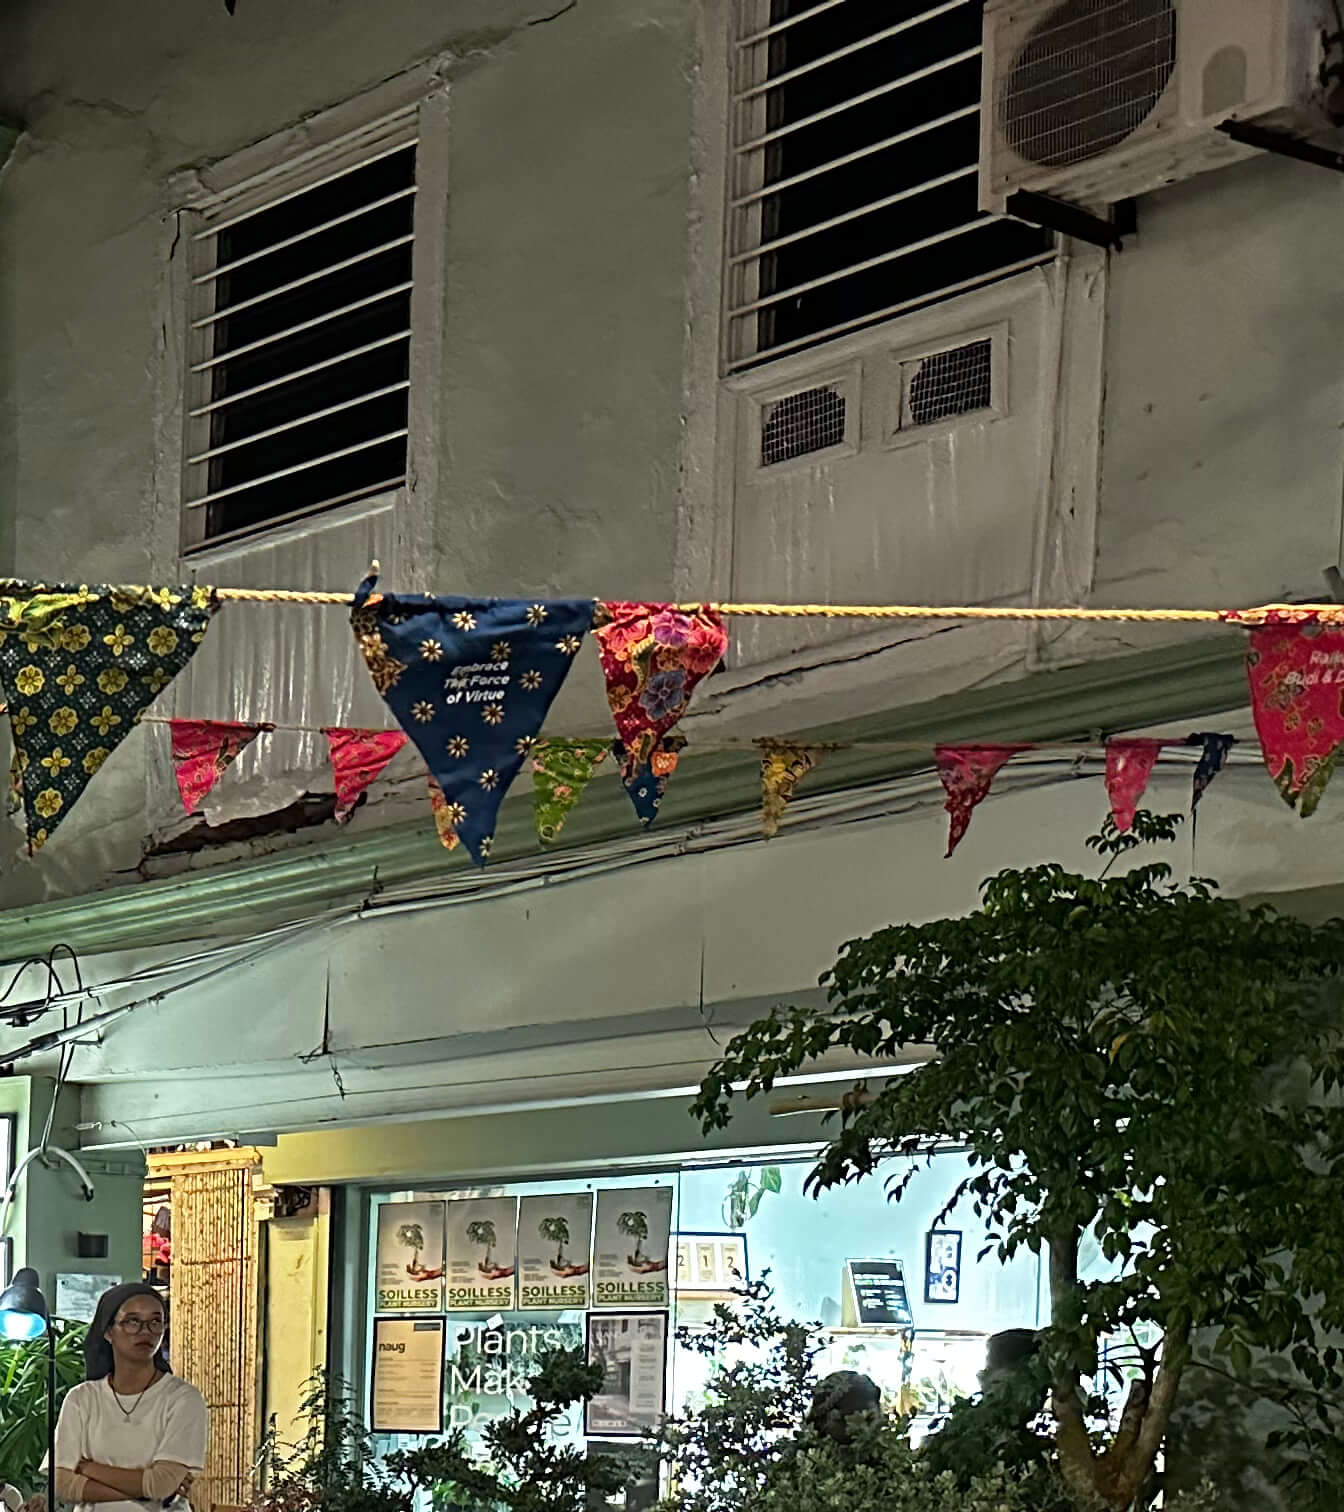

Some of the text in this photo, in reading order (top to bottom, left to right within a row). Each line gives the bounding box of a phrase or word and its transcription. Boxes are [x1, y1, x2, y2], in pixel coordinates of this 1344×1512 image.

[451, 661, 509, 676] Embrace
[470, 675, 510, 686] Force
[446, 690, 505, 704] of Virtue
[448, 1287, 512, 1298] SOILLESS
[522, 1285, 585, 1297] SOILLESS
[597, 1282, 665, 1293] SOILLESS
[378, 1288, 438, 1300] SOILLESS
[455, 1324, 565, 1355] Plants
[378, 1342, 407, 1354] naug
[450, 1364, 529, 1397] Mak
